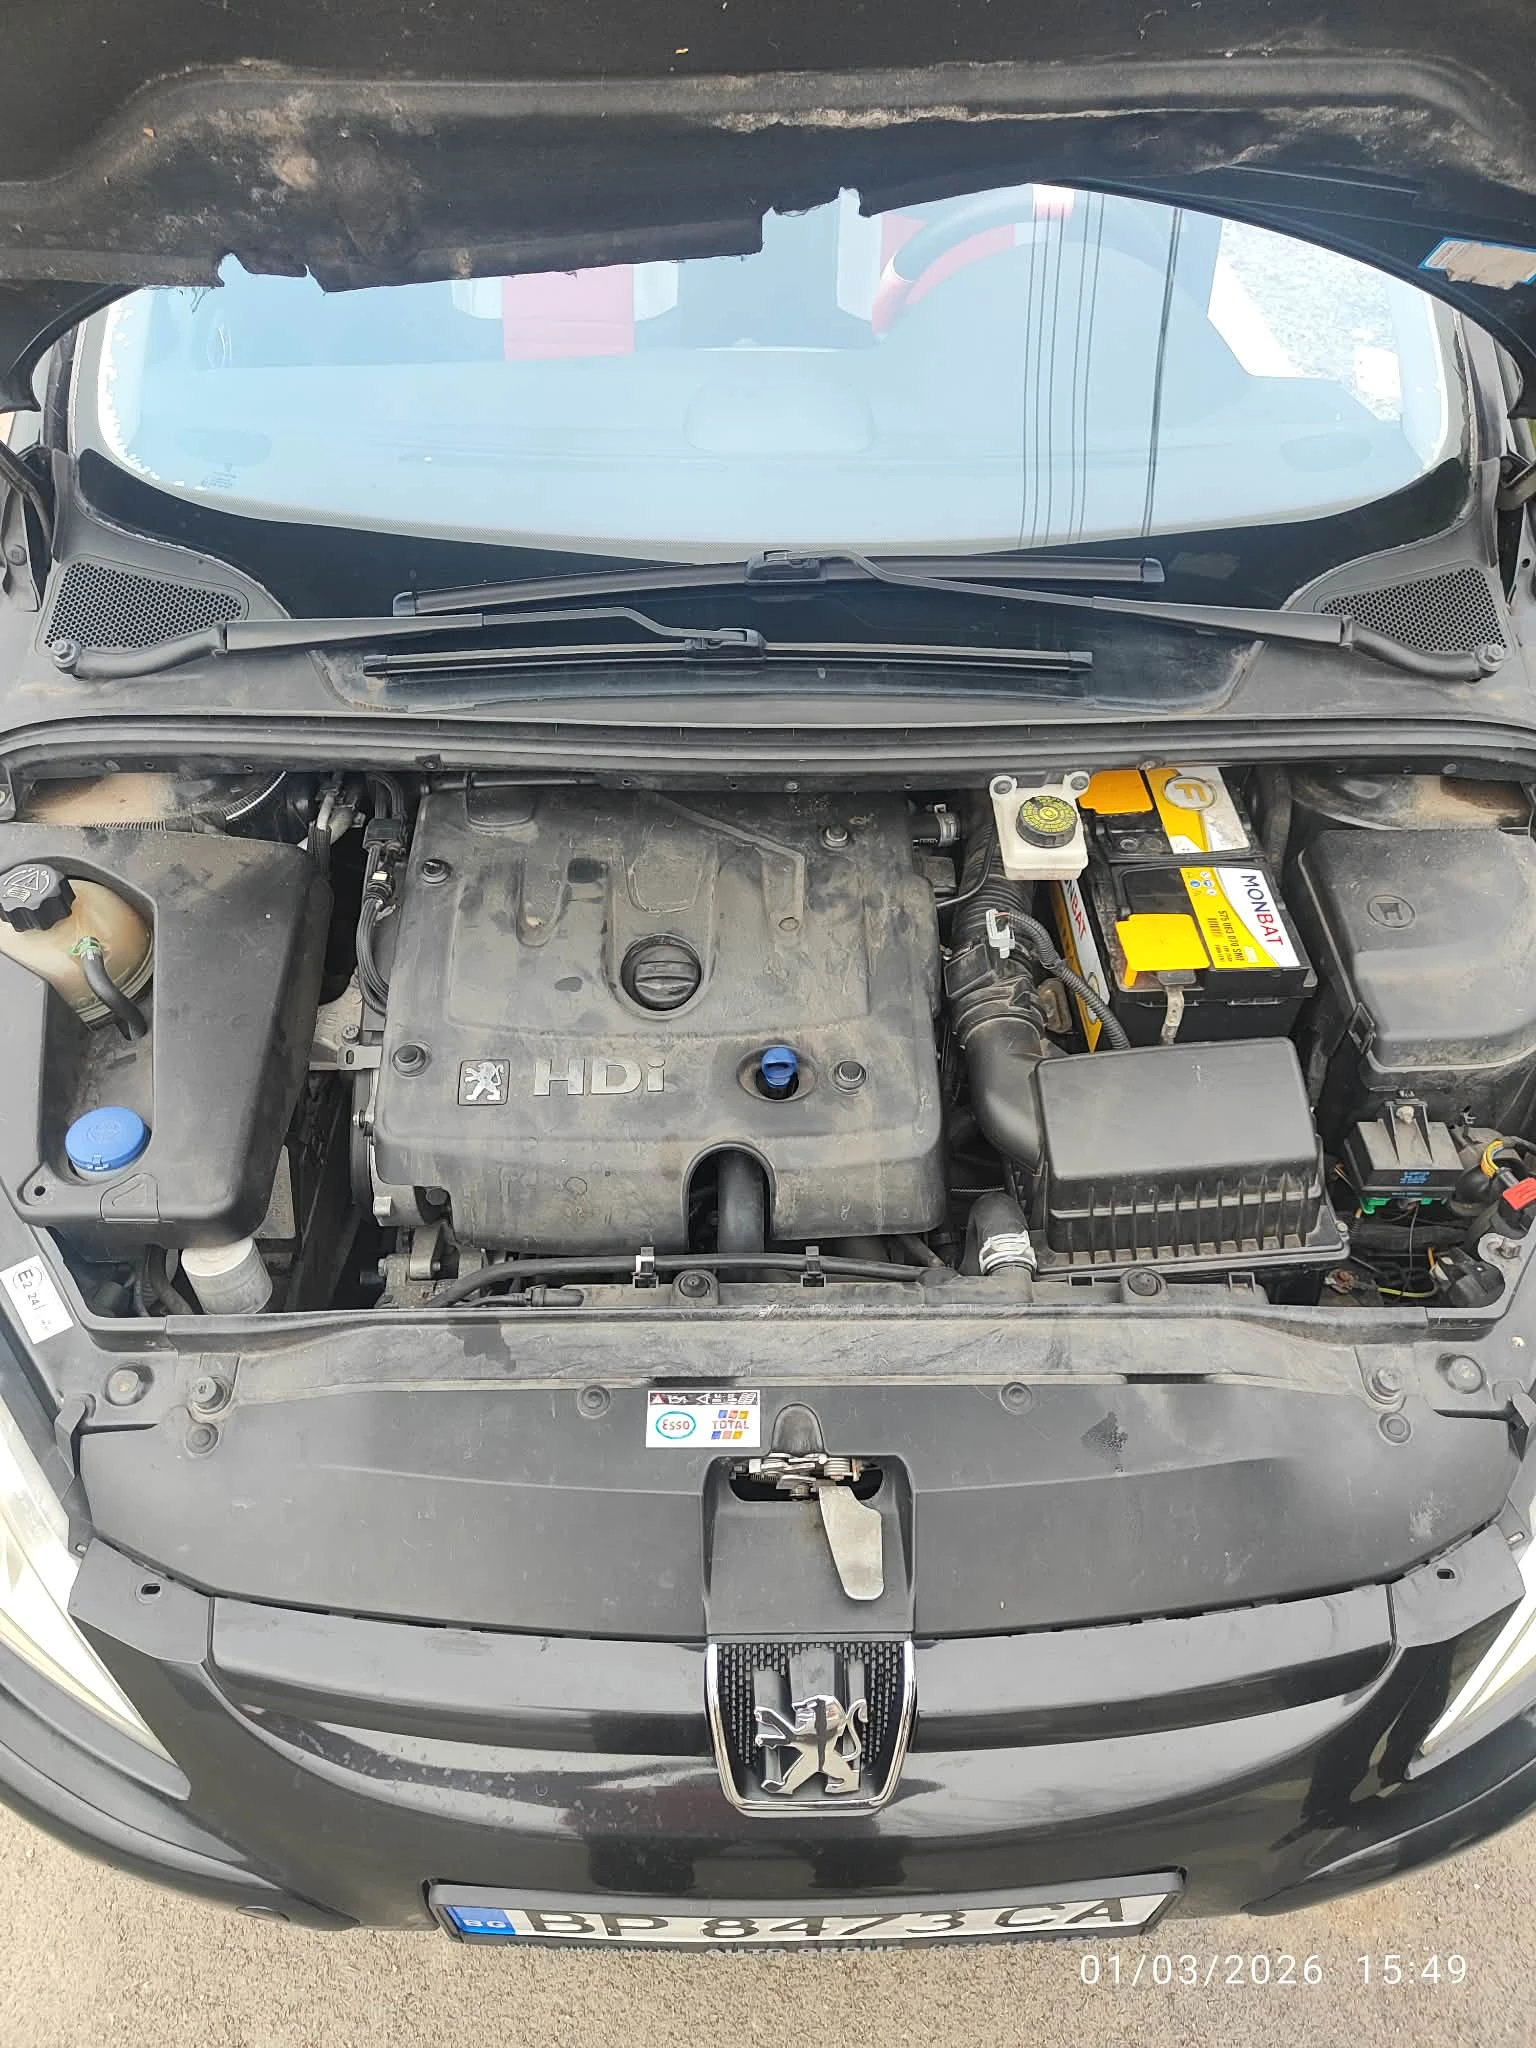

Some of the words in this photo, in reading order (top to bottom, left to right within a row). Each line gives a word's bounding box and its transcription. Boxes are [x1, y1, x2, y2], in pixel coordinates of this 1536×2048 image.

[1240, 875, 1284, 946] MONBAT
[534, 1058, 666, 1096] HDi
[711, 1420, 750, 1430] TOTAL
[463, 1919, 507, 1930] BG
[524, 1910, 669, 1937] BP
[700, 1911, 965, 1939] 8473
[994, 1898, 1125, 1928] CA
